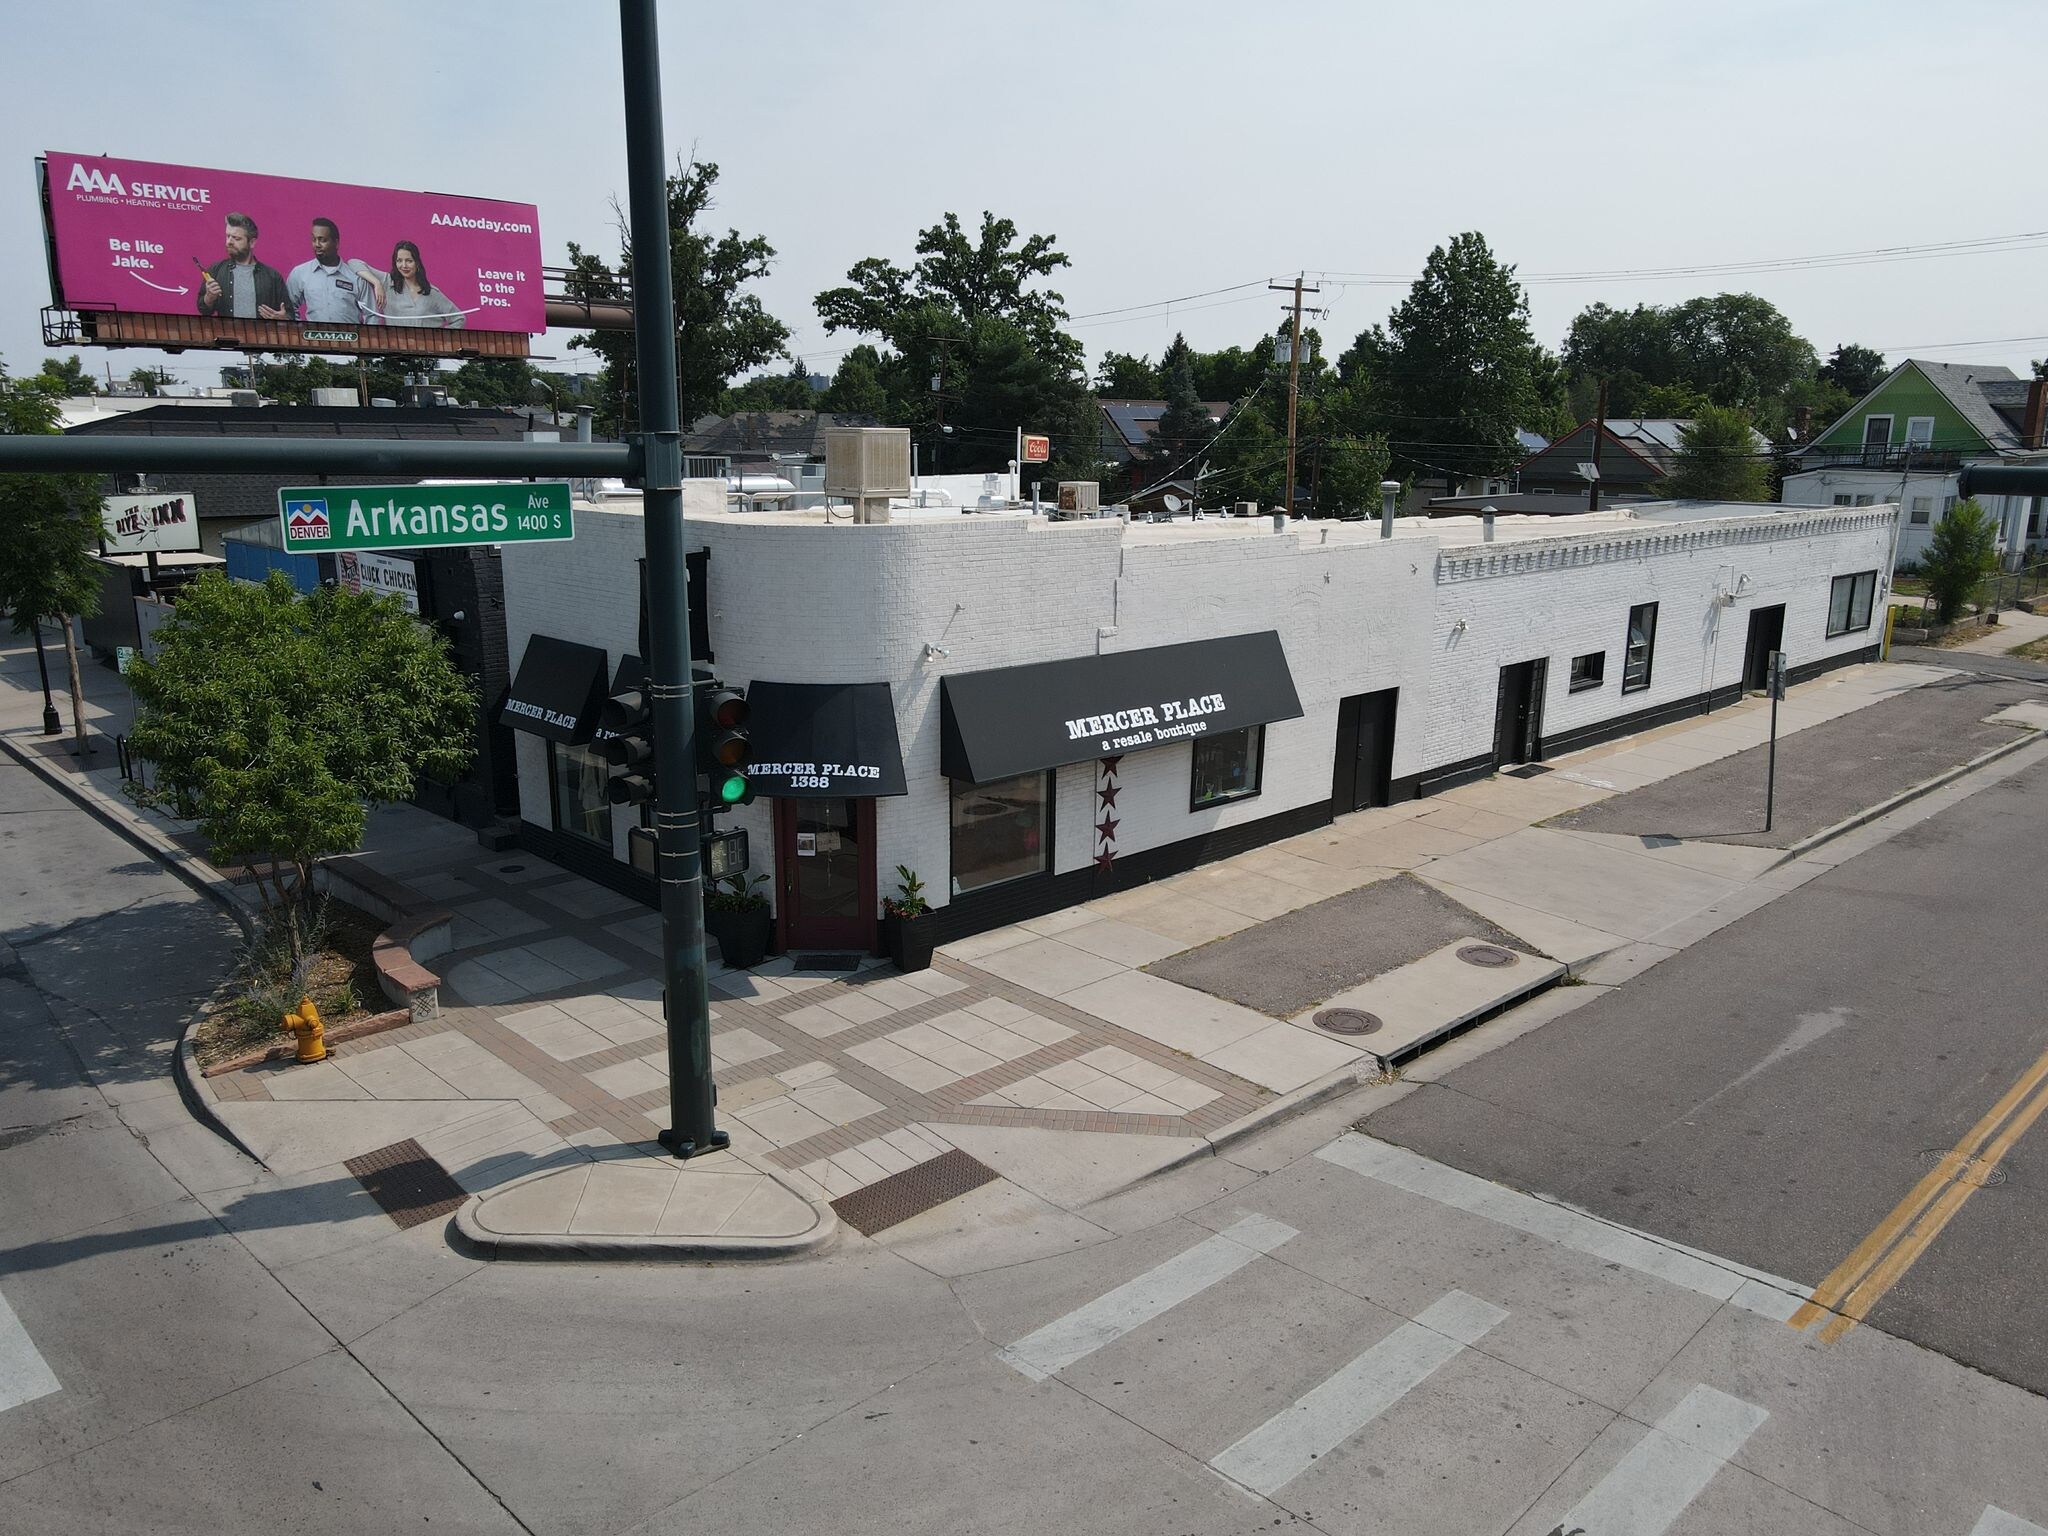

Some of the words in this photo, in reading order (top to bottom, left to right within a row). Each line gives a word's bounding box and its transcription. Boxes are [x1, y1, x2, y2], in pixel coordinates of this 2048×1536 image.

[66, 163, 127, 196] AAA
[131, 182, 211, 204] SERVICE
[76, 194, 119, 205] PLUMBING
[126, 198, 161, 208] HEATING
[167, 202, 203, 212] ELECTRIC
[431, 213, 532, 233] AAAtoday.com
[109, 238, 131, 252] Be
[135, 240, 164, 254] like
[112, 255, 154, 269] Jake.
[477, 268, 514, 281] Leave
[516, 271, 526, 281] it
[479, 282, 492, 292] to
[495, 283, 515, 294] the
[480, 295, 511, 307] Pros.
[307, 332, 353, 340] LAMAR
[527, 494, 549, 509] Ave
[346, 499, 508, 537] Arkansas
[517, 515, 548, 530] 1400
[553, 514, 561, 529] S
[290, 525, 330, 539] DENVER
[361, 563, 381, 585] CLUCK
[383, 568, 418, 591] CHICKEN
[505, 698, 544, 720] MERCER
[544, 709, 577, 730] PLACE
[1065, 705, 1160, 740] MERCER
[1160, 693, 1226, 722] PLACE
[1101, 739, 1111, 751] a
[1113, 731, 1153, 748] resale
[1154, 721, 1207, 740] boutique
[747, 763, 817, 776] MERCER
[821, 764, 880, 779] PLACE
[790, 775, 830, 788] 1388
